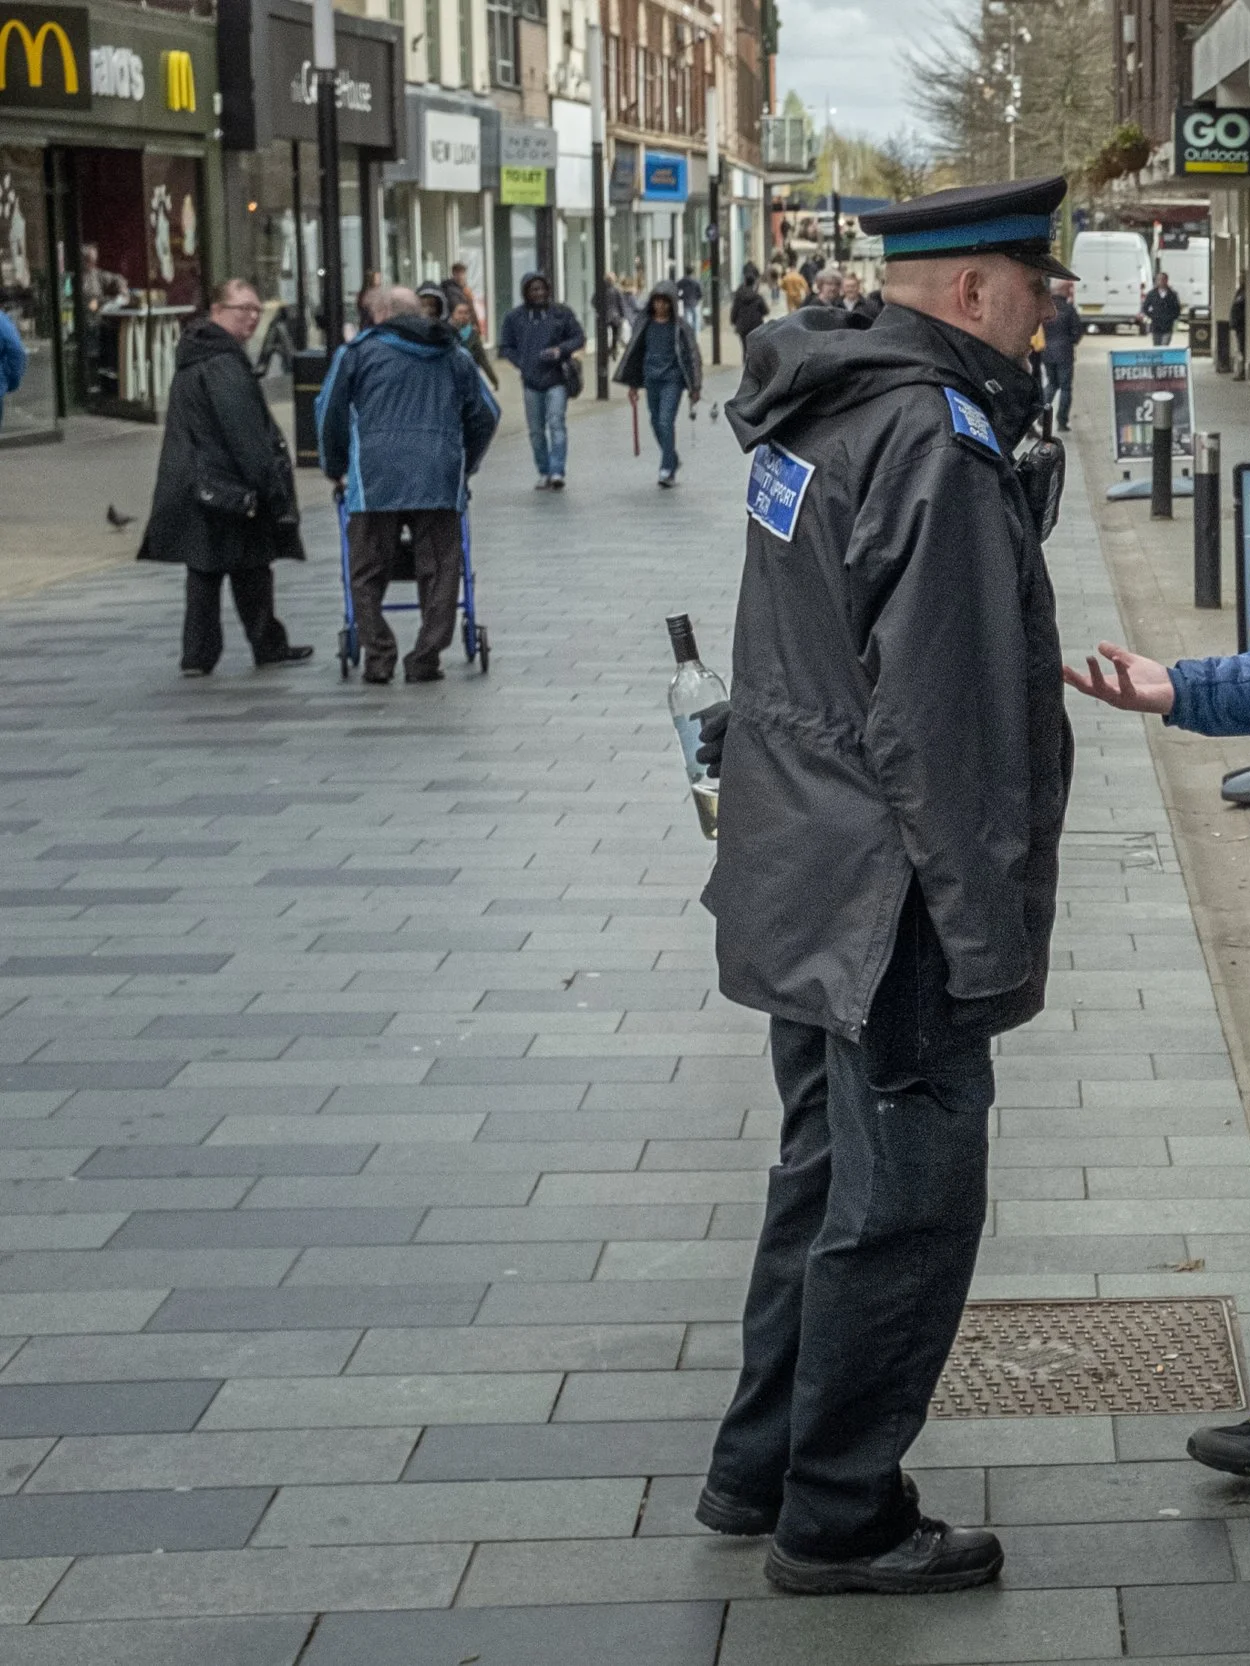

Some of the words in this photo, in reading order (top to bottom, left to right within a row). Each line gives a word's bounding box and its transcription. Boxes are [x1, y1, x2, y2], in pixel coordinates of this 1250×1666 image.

[1183, 112, 1250, 148] GO
[1184, 147, 1250, 162] Outdoors
[505, 169, 520, 182] TO
[522, 169, 542, 184] LET
[1114, 365, 1154, 380] SPECIAL
